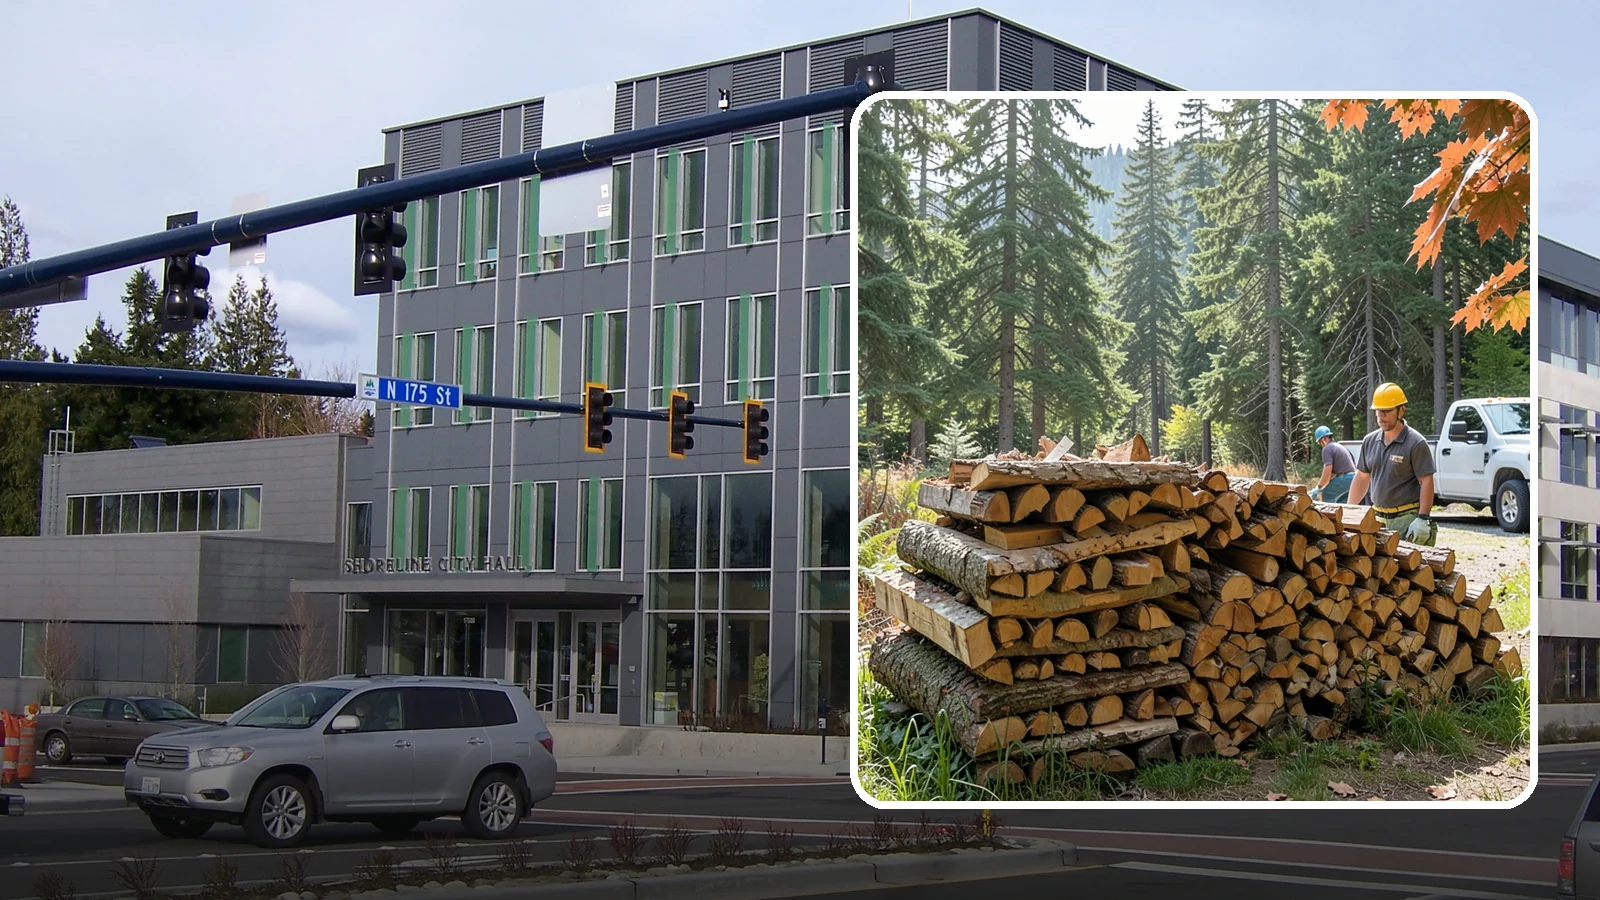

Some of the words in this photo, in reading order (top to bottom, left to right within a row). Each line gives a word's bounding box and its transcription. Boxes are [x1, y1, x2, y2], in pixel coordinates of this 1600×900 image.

[387, 380, 396, 399] N
[405, 383, 427, 403] 175
[436, 386, 451, 406] St
[344, 558, 432, 573] SHORELINE
[438, 557, 476, 572] CITY
[484, 557, 525, 571] HALL
